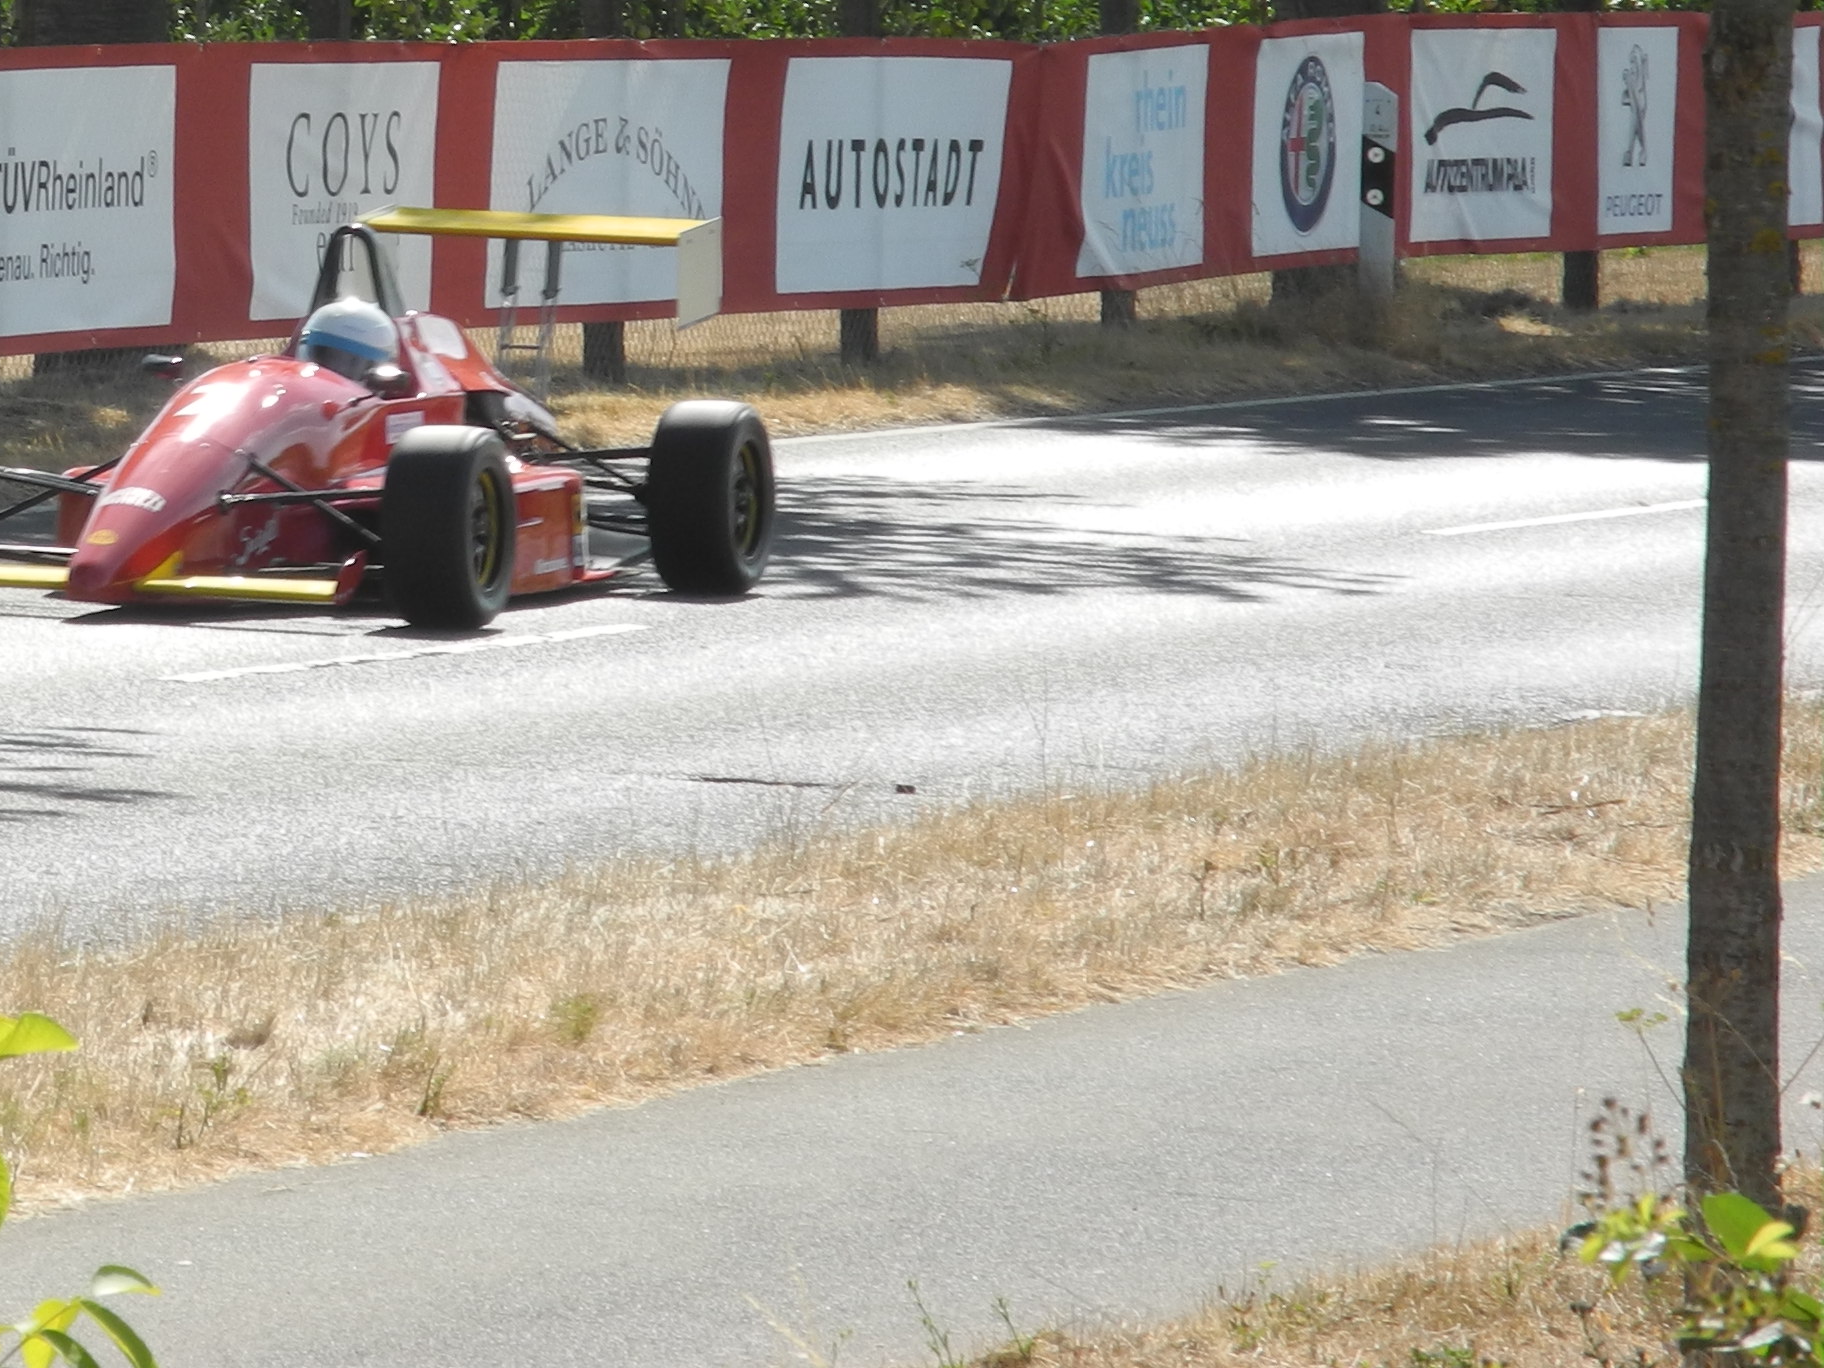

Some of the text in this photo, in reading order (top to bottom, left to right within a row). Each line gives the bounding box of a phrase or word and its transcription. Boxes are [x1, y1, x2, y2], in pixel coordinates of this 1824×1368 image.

[1135, 68, 1186, 132] rhein
[286, 110, 402, 198] COYS
[527, 118, 608, 213] LANGE
[615, 116, 631, 155] &
[799, 138, 984, 210] AUTOSTADT
[1104, 135, 1153, 199] kreis
[291, 200, 333, 225] Founded
[1121, 202, 1176, 253] neuss
[1606, 193, 1663, 218] PEUGEOT
[39, 240, 96, 284] Richtig.
